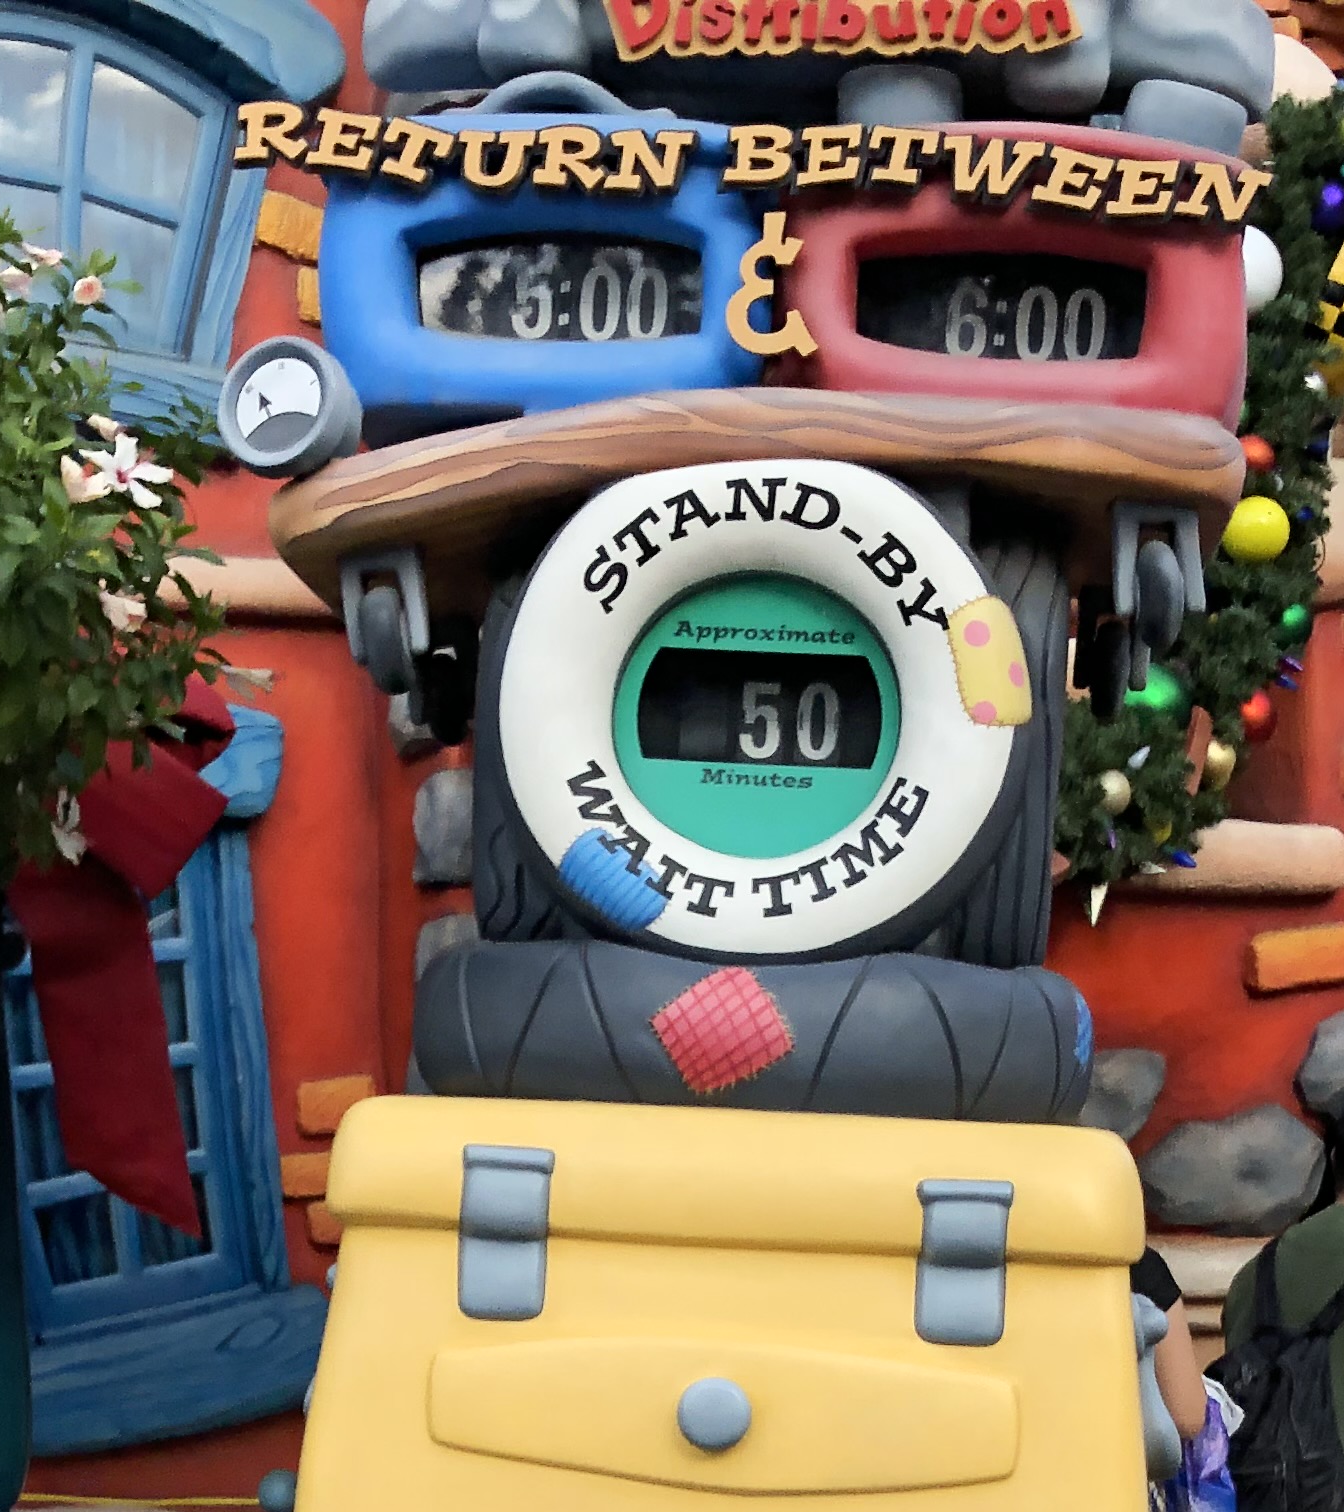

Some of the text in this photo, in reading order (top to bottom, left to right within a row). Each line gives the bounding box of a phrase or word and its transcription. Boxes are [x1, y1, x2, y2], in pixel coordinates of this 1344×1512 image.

[233, 101, 1272, 222] RETURN BETWEEN
[511, 262, 668, 340] 5:00
[726, 211, 818, 357] &
[945, 275, 1105, 361] 6:00
[582, 476, 950, 632] STAND-BY
[674, 620, 856, 645] Approximate
[737, 681, 840, 761] 50
[700, 768, 813, 790] Minutes
[566, 761, 929, 918] WAIT TIME
